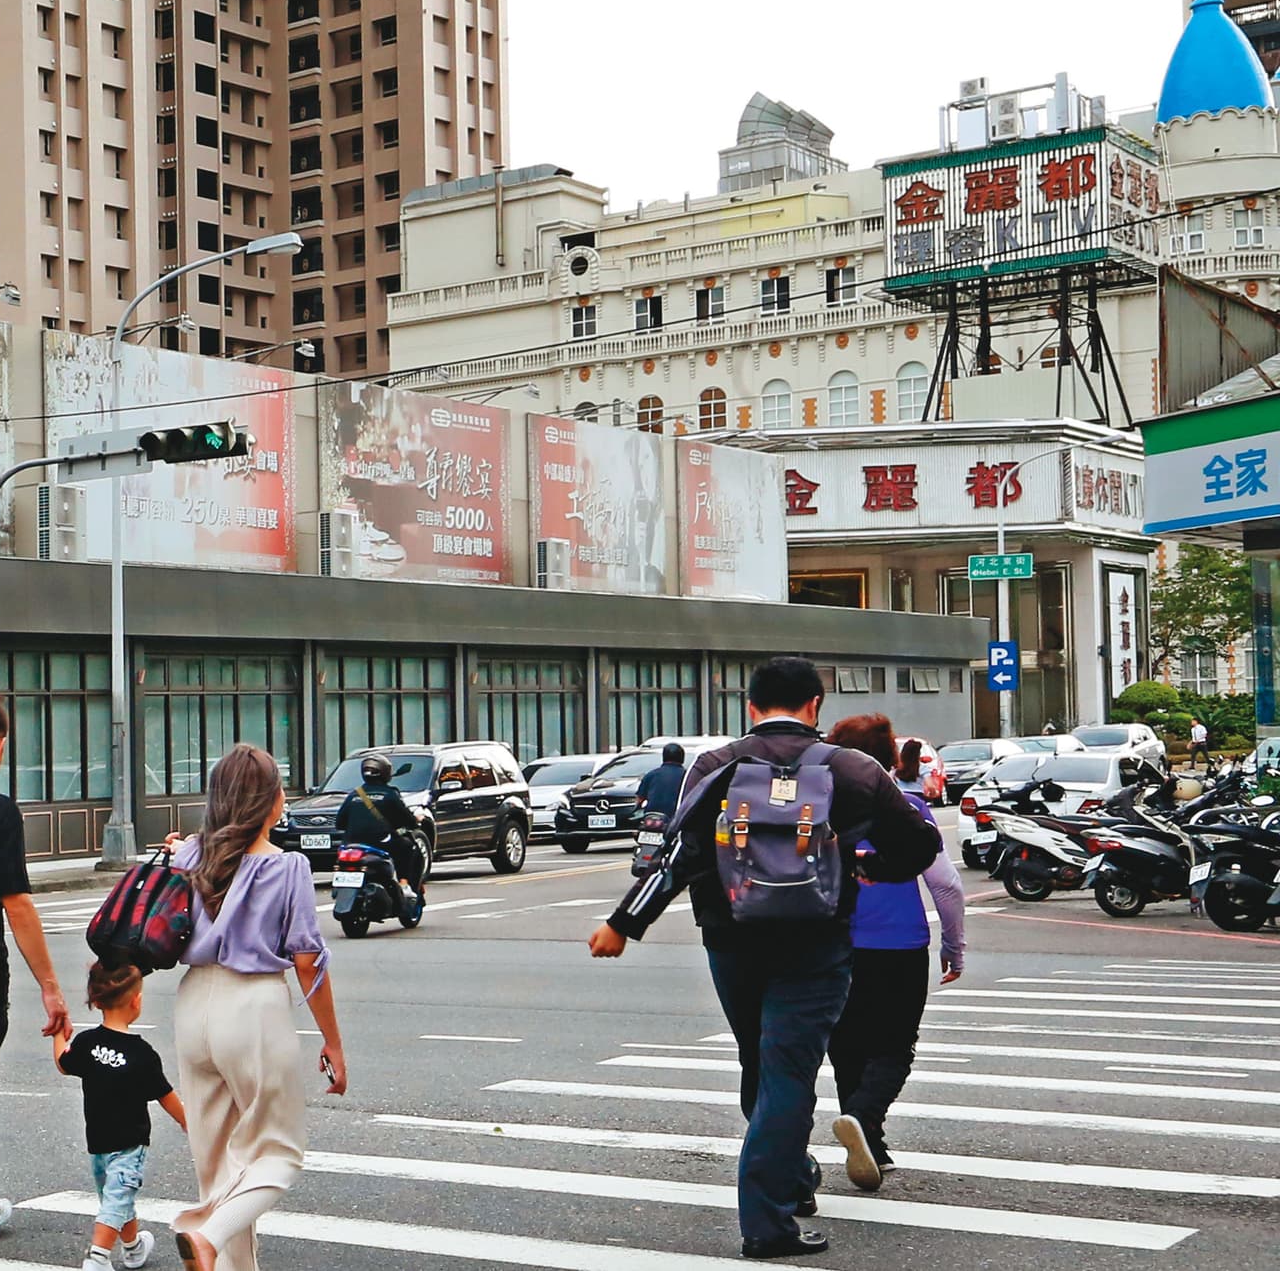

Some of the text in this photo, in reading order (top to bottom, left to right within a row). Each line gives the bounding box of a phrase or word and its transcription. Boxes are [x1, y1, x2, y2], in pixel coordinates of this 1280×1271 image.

[895, 153, 1097, 226] 金麗都
[1203, 449, 1268, 503] 全家
